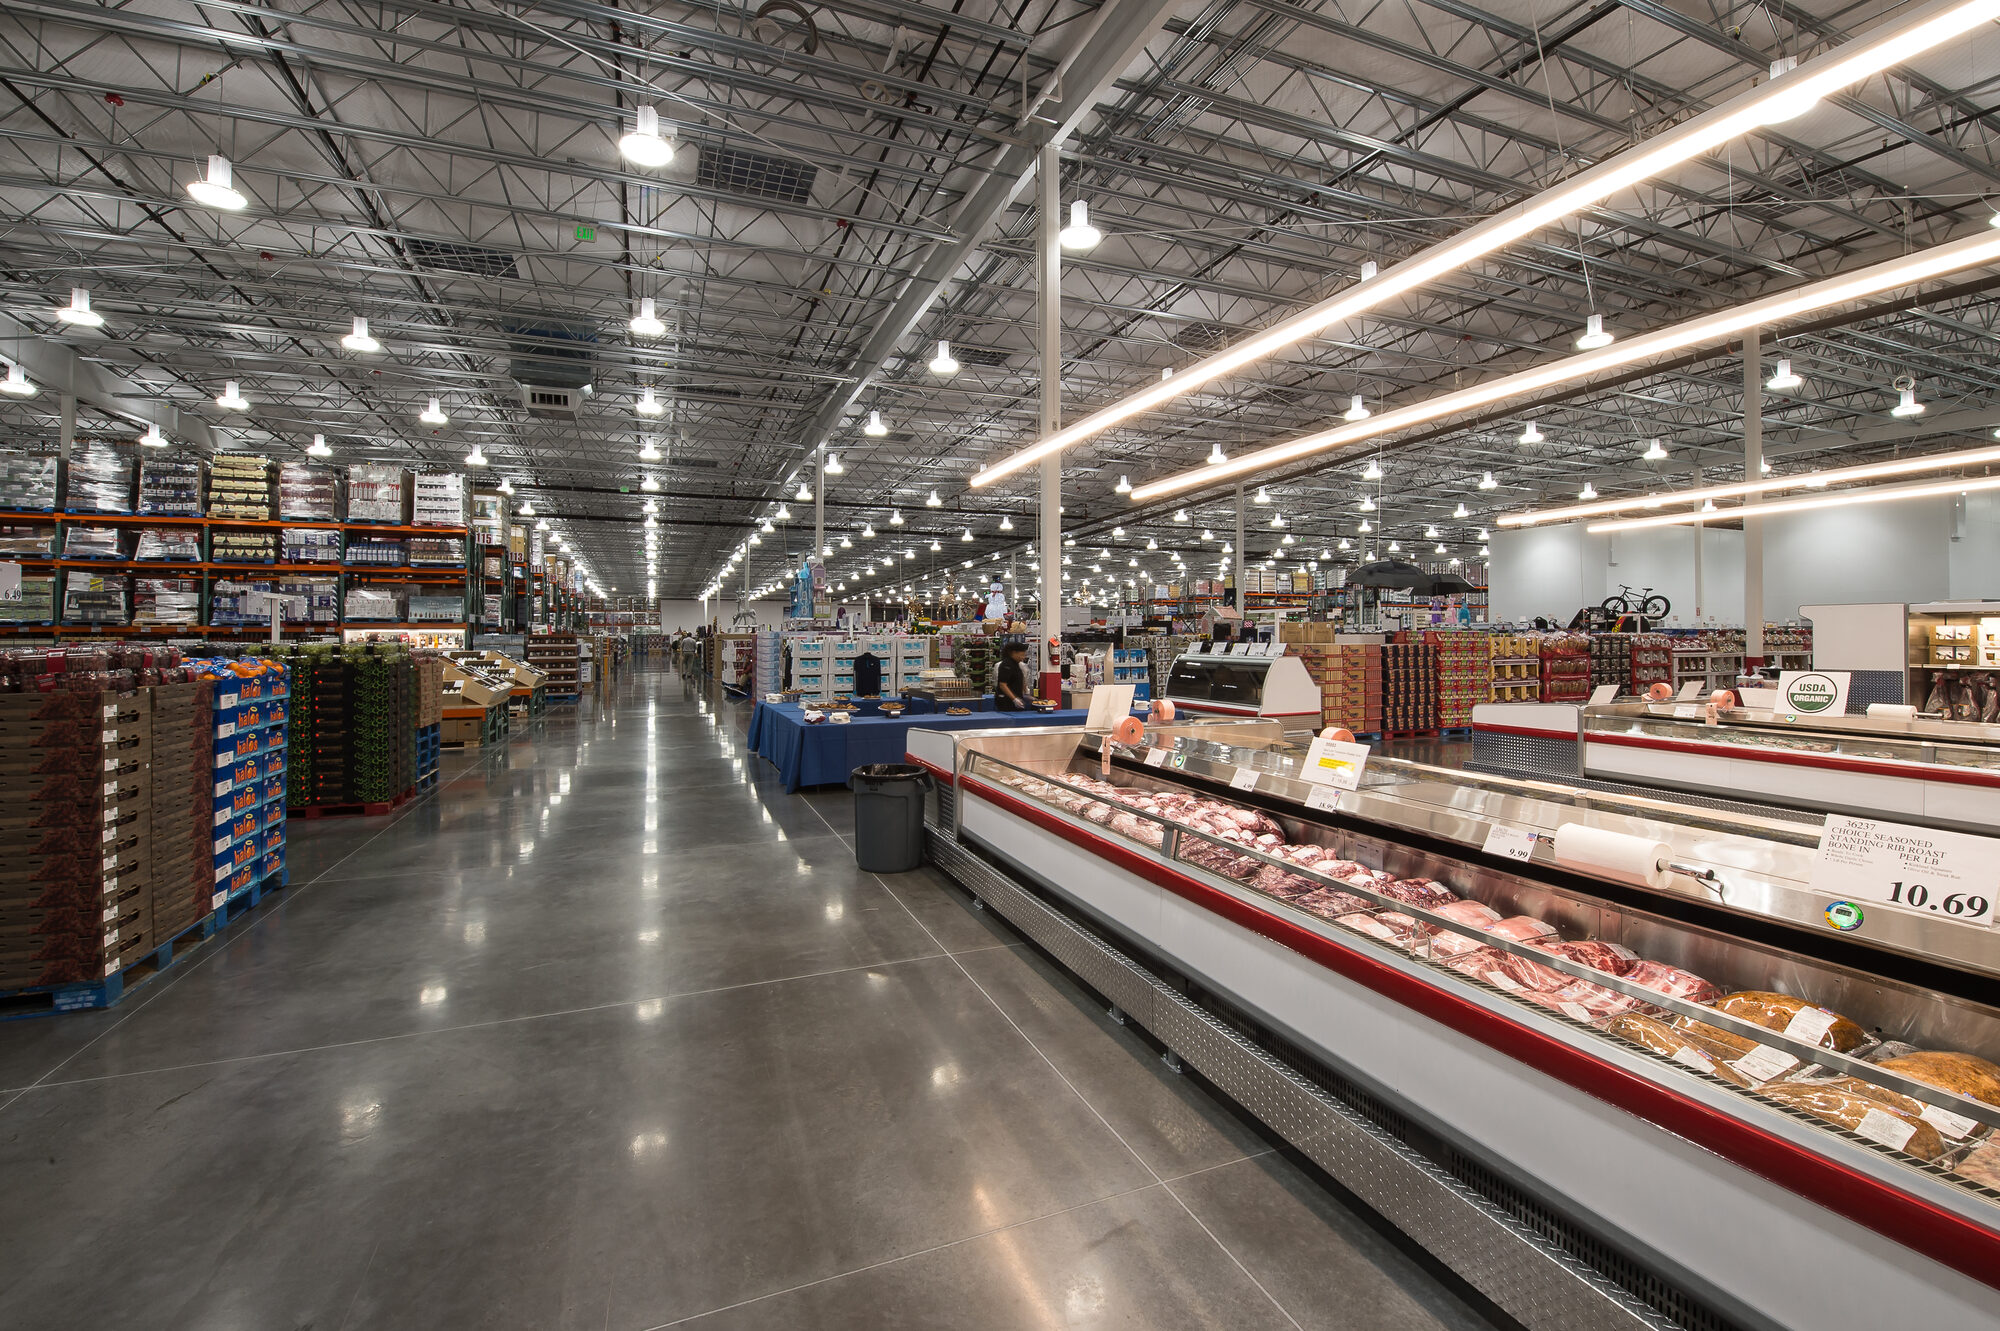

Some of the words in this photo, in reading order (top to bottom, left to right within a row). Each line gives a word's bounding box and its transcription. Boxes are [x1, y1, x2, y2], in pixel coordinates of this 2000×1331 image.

[576, 226, 595, 241] EXIT
[476, 533, 492, 544] 115
[509, 552, 523, 561] 113
[4, 589, 22, 600] 6.49
[240, 681, 262, 699] halos
[1799, 683, 1826, 692] USDA
[1793, 694, 1829, 703] ORGANIC
[238, 709, 260, 729] halos
[236, 737, 258, 756] halos
[235, 764, 257, 784] halos
[234, 791, 256, 811] halos
[233, 818, 256, 839] halos
[1845, 820, 1876, 830] 36237
[1828, 841, 1857, 851] BONE
[1831, 826, 1871, 838] CHOICE
[1874, 833, 1933, 848] SEASONED
[234, 844, 256, 866] halos
[1509, 848, 1528, 858] 9.99
[1829, 834, 1884, 848] STANDING
[1886, 843, 1906, 852] RIB
[1908, 846, 1947, 859] ROAST
[1899, 853, 1920, 863] PER
[1924, 857, 1939, 866] LB
[231, 870, 252, 892] halos
[1886, 881, 1989, 918] 10.69
